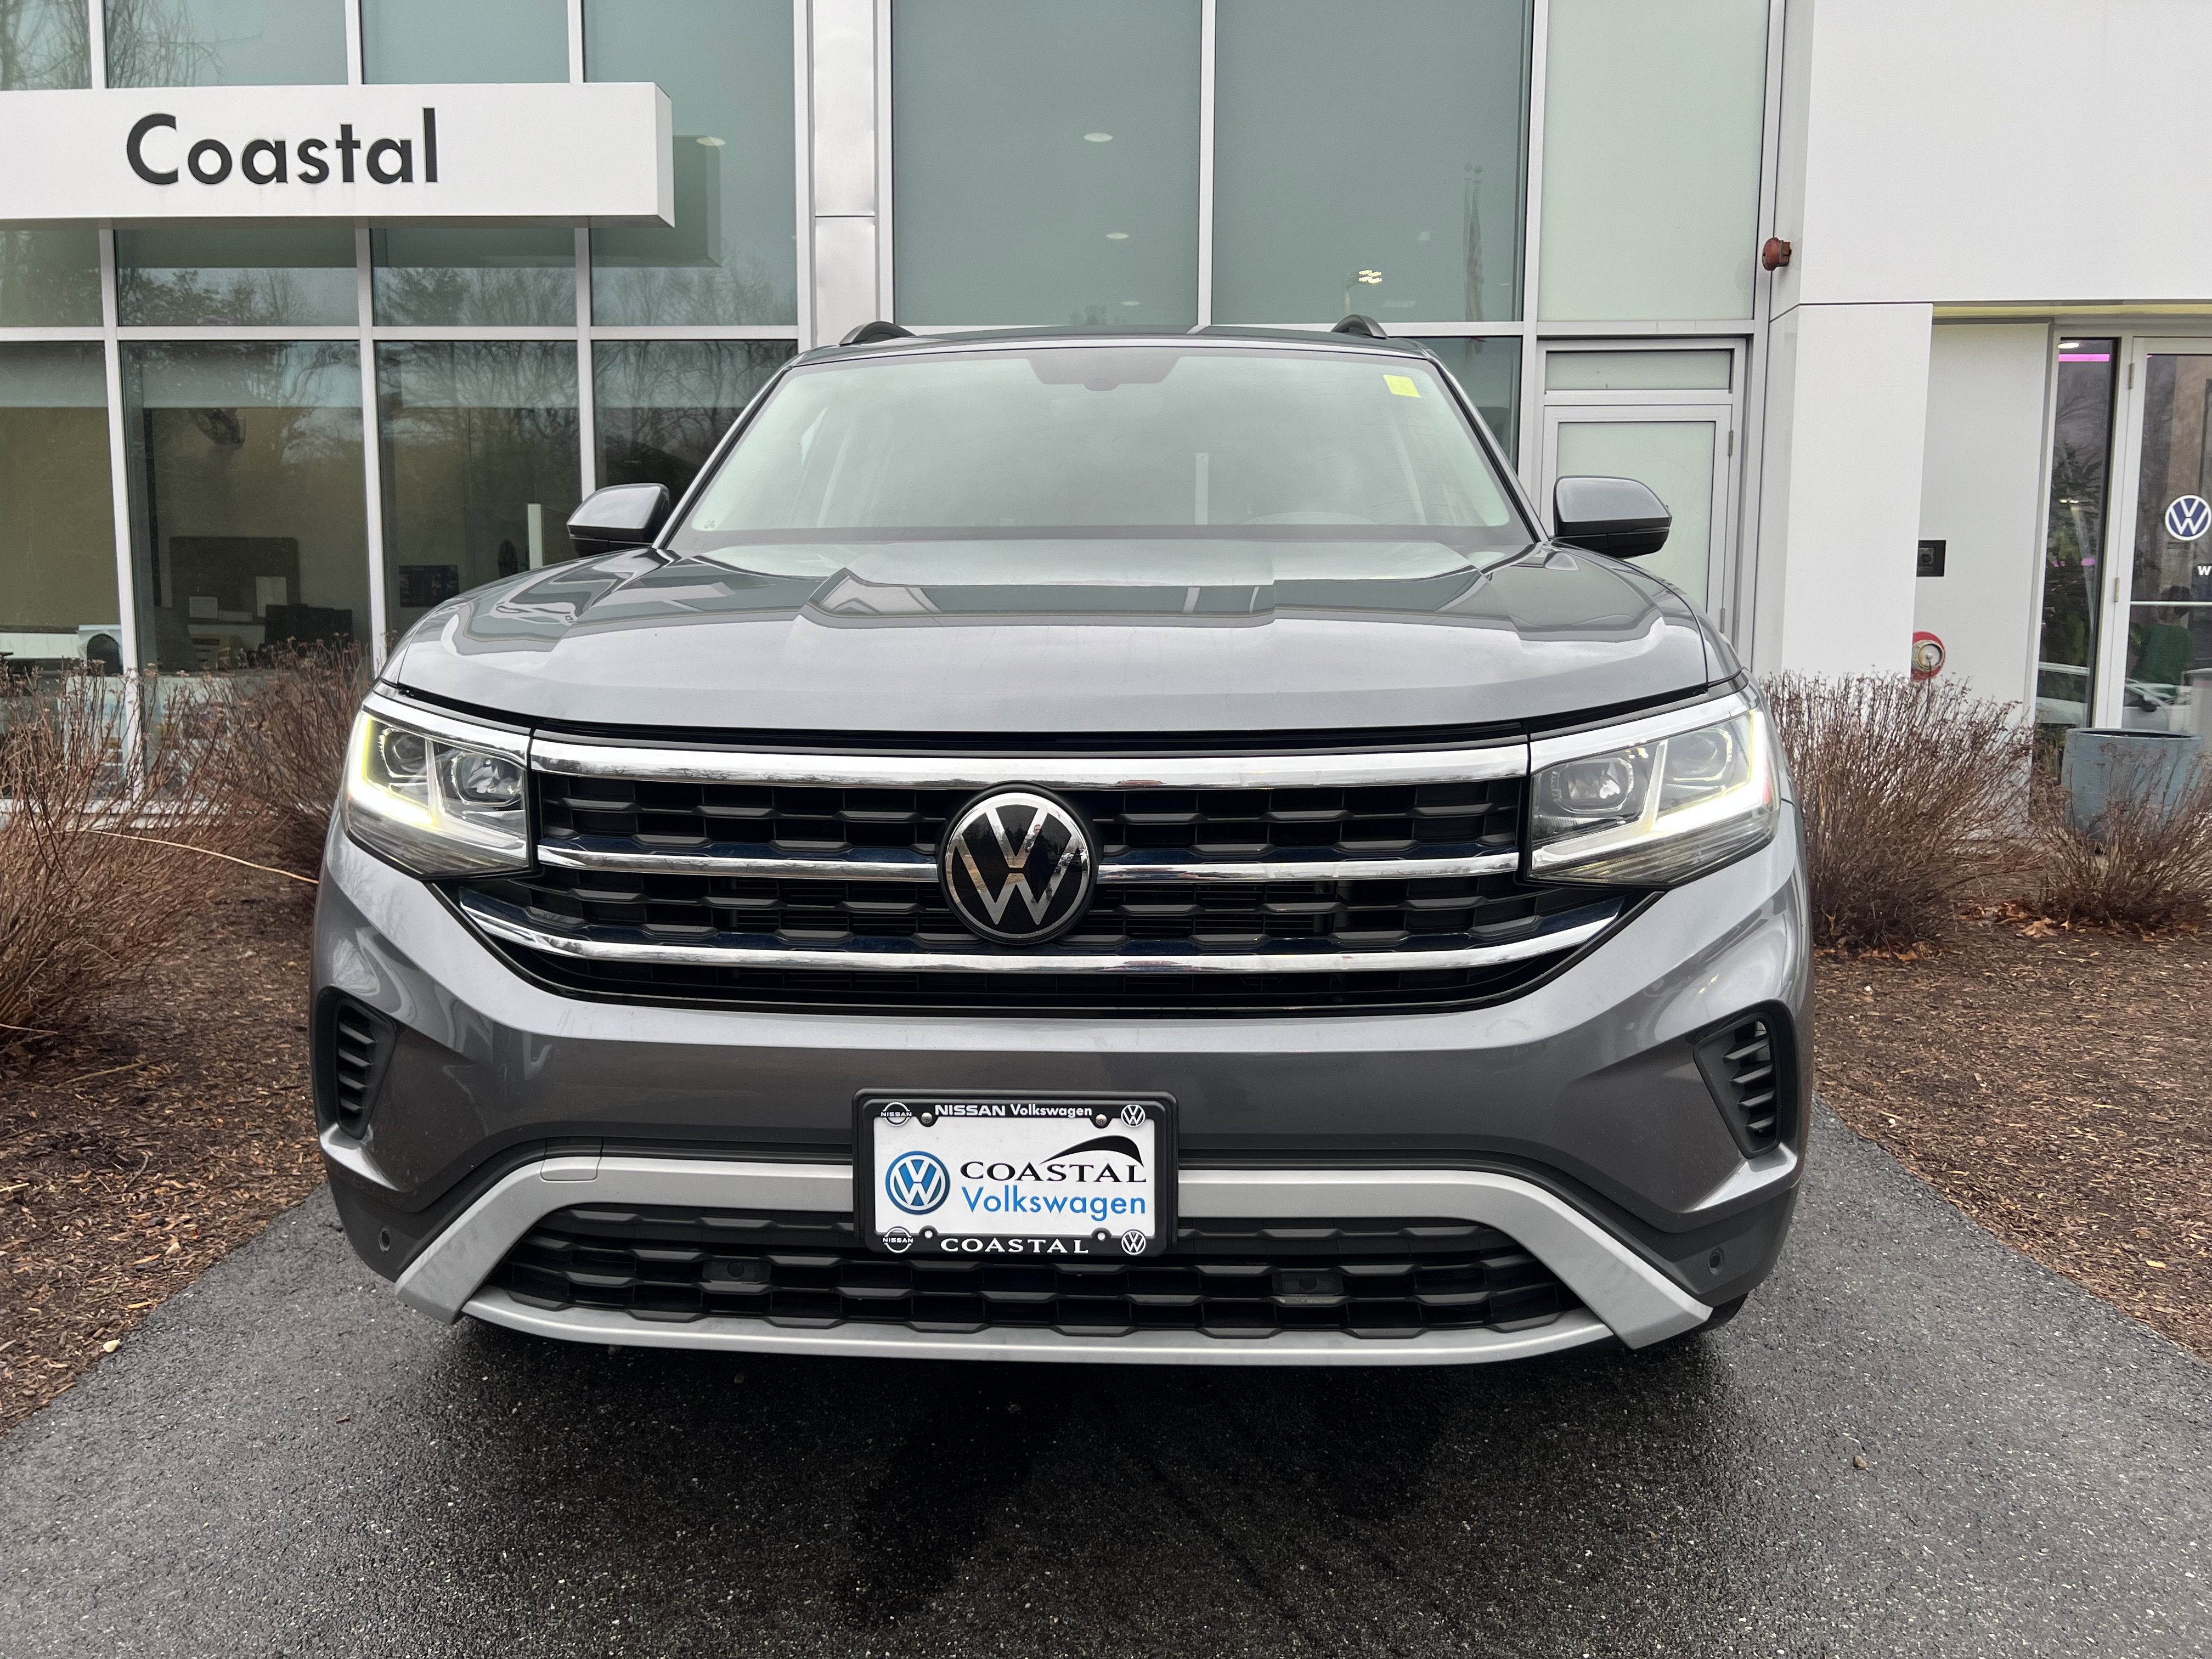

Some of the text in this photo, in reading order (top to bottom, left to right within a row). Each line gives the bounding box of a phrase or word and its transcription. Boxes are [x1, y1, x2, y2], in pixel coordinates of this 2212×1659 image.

[126, 106, 439, 185] Coastal
[2168, 496, 2209, 537] VW
[949, 798, 1086, 928] VW
[935, 1103, 1092, 1118] NISSAN Volkswagen
[1122, 1105, 1144, 1126] VW
[890, 1155, 946, 1210] VW
[960, 1161, 1146, 1183] COASTAL
[961, 1184, 1146, 1221] Volkswagen
[940, 1237, 1088, 1254] COASTAL
[1122, 1231, 1145, 1254] VW
